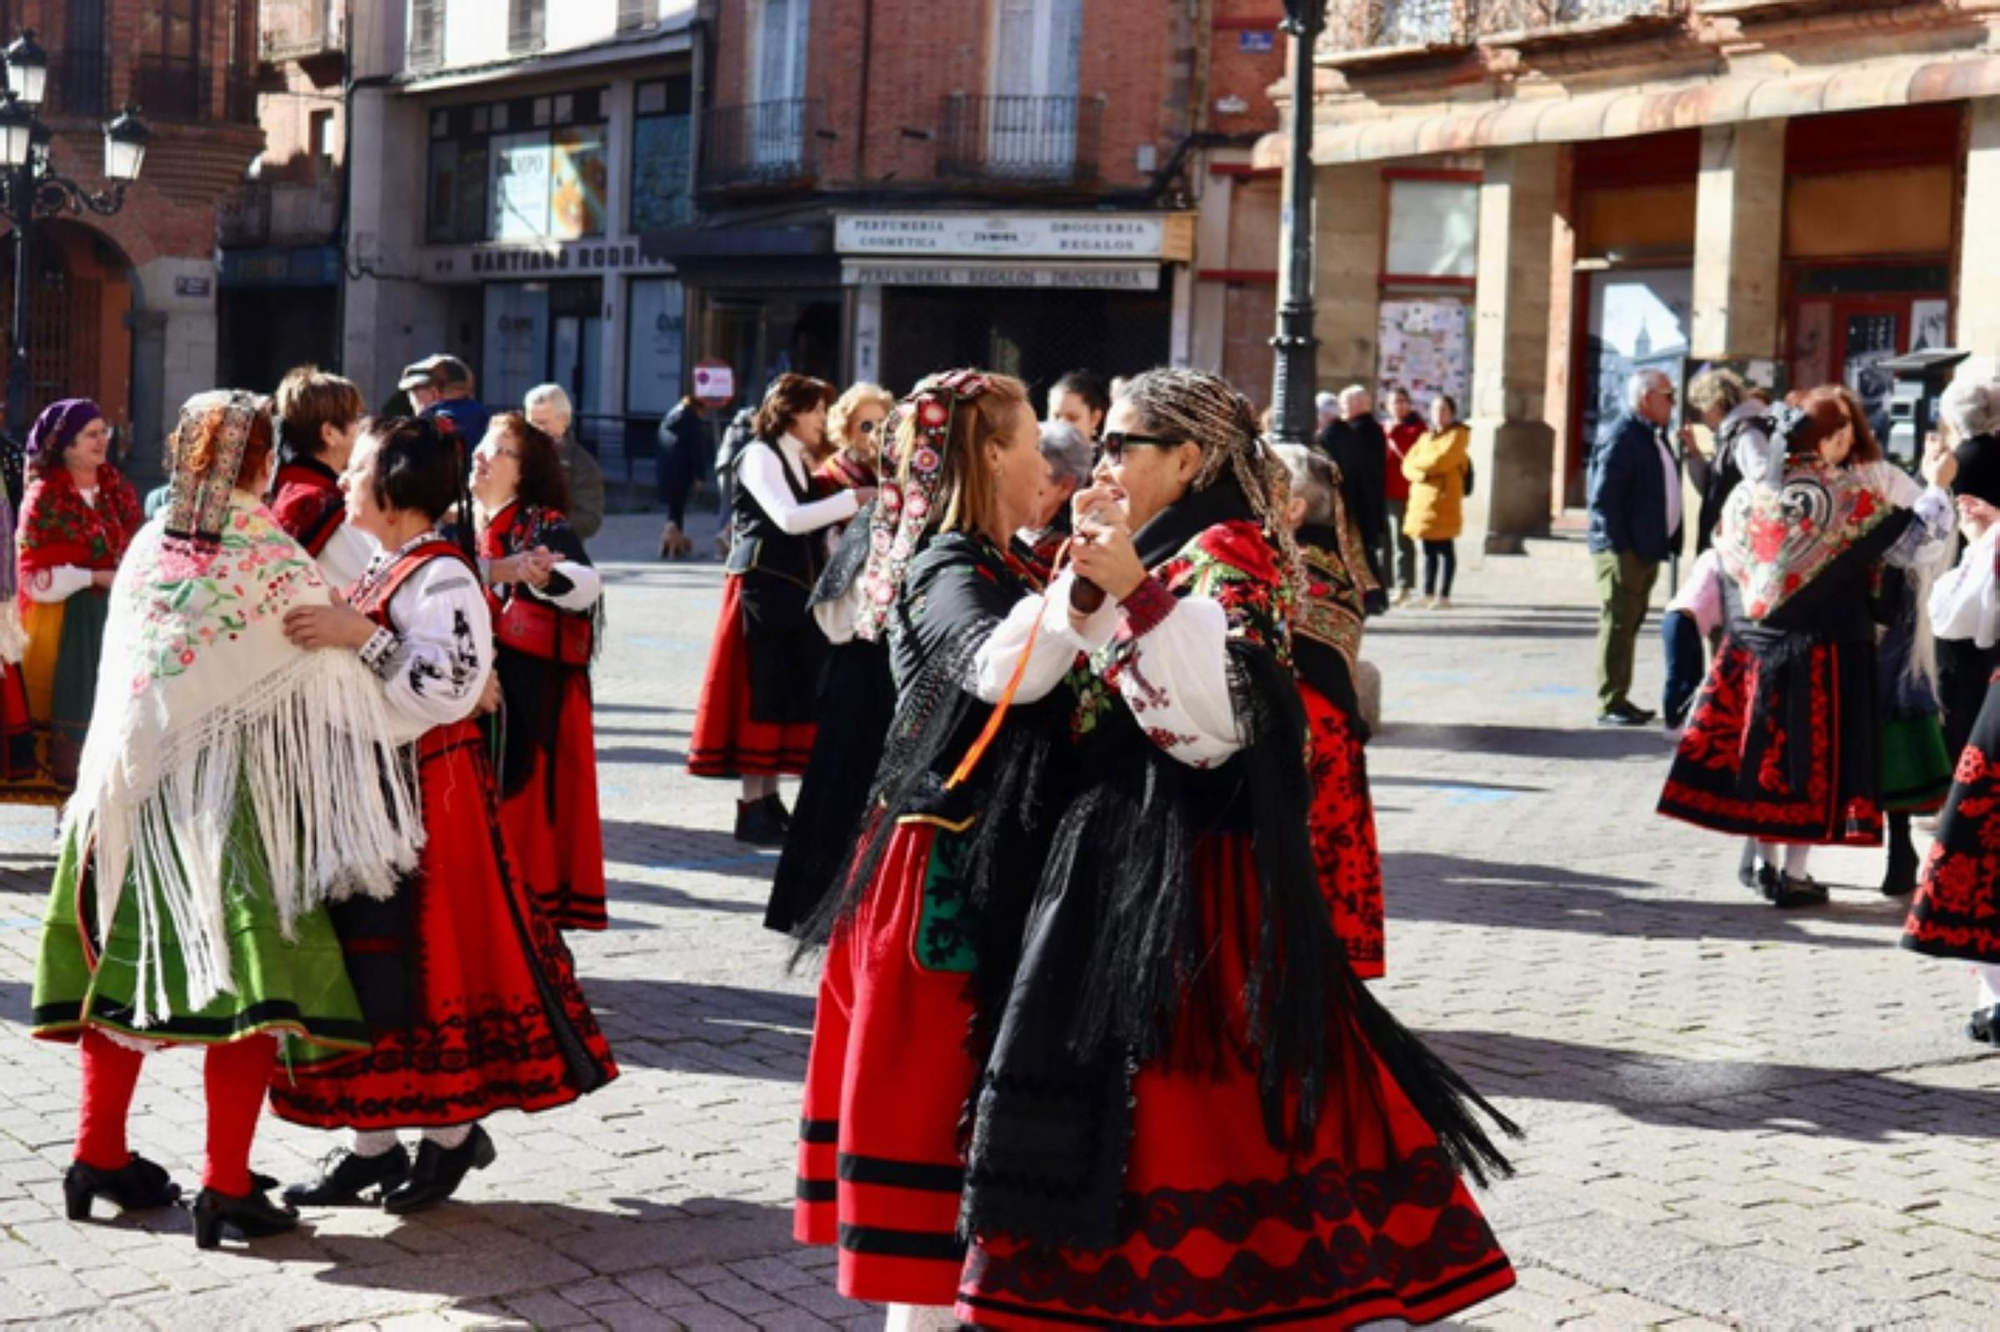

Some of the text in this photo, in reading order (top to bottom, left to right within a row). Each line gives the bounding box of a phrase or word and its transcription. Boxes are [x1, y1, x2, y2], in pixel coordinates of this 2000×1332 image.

[855, 220, 944, 231] PERFUMERIA
[1051, 223, 1144, 233] DROGUERIA
[1059, 240, 1134, 250] REGALOS
